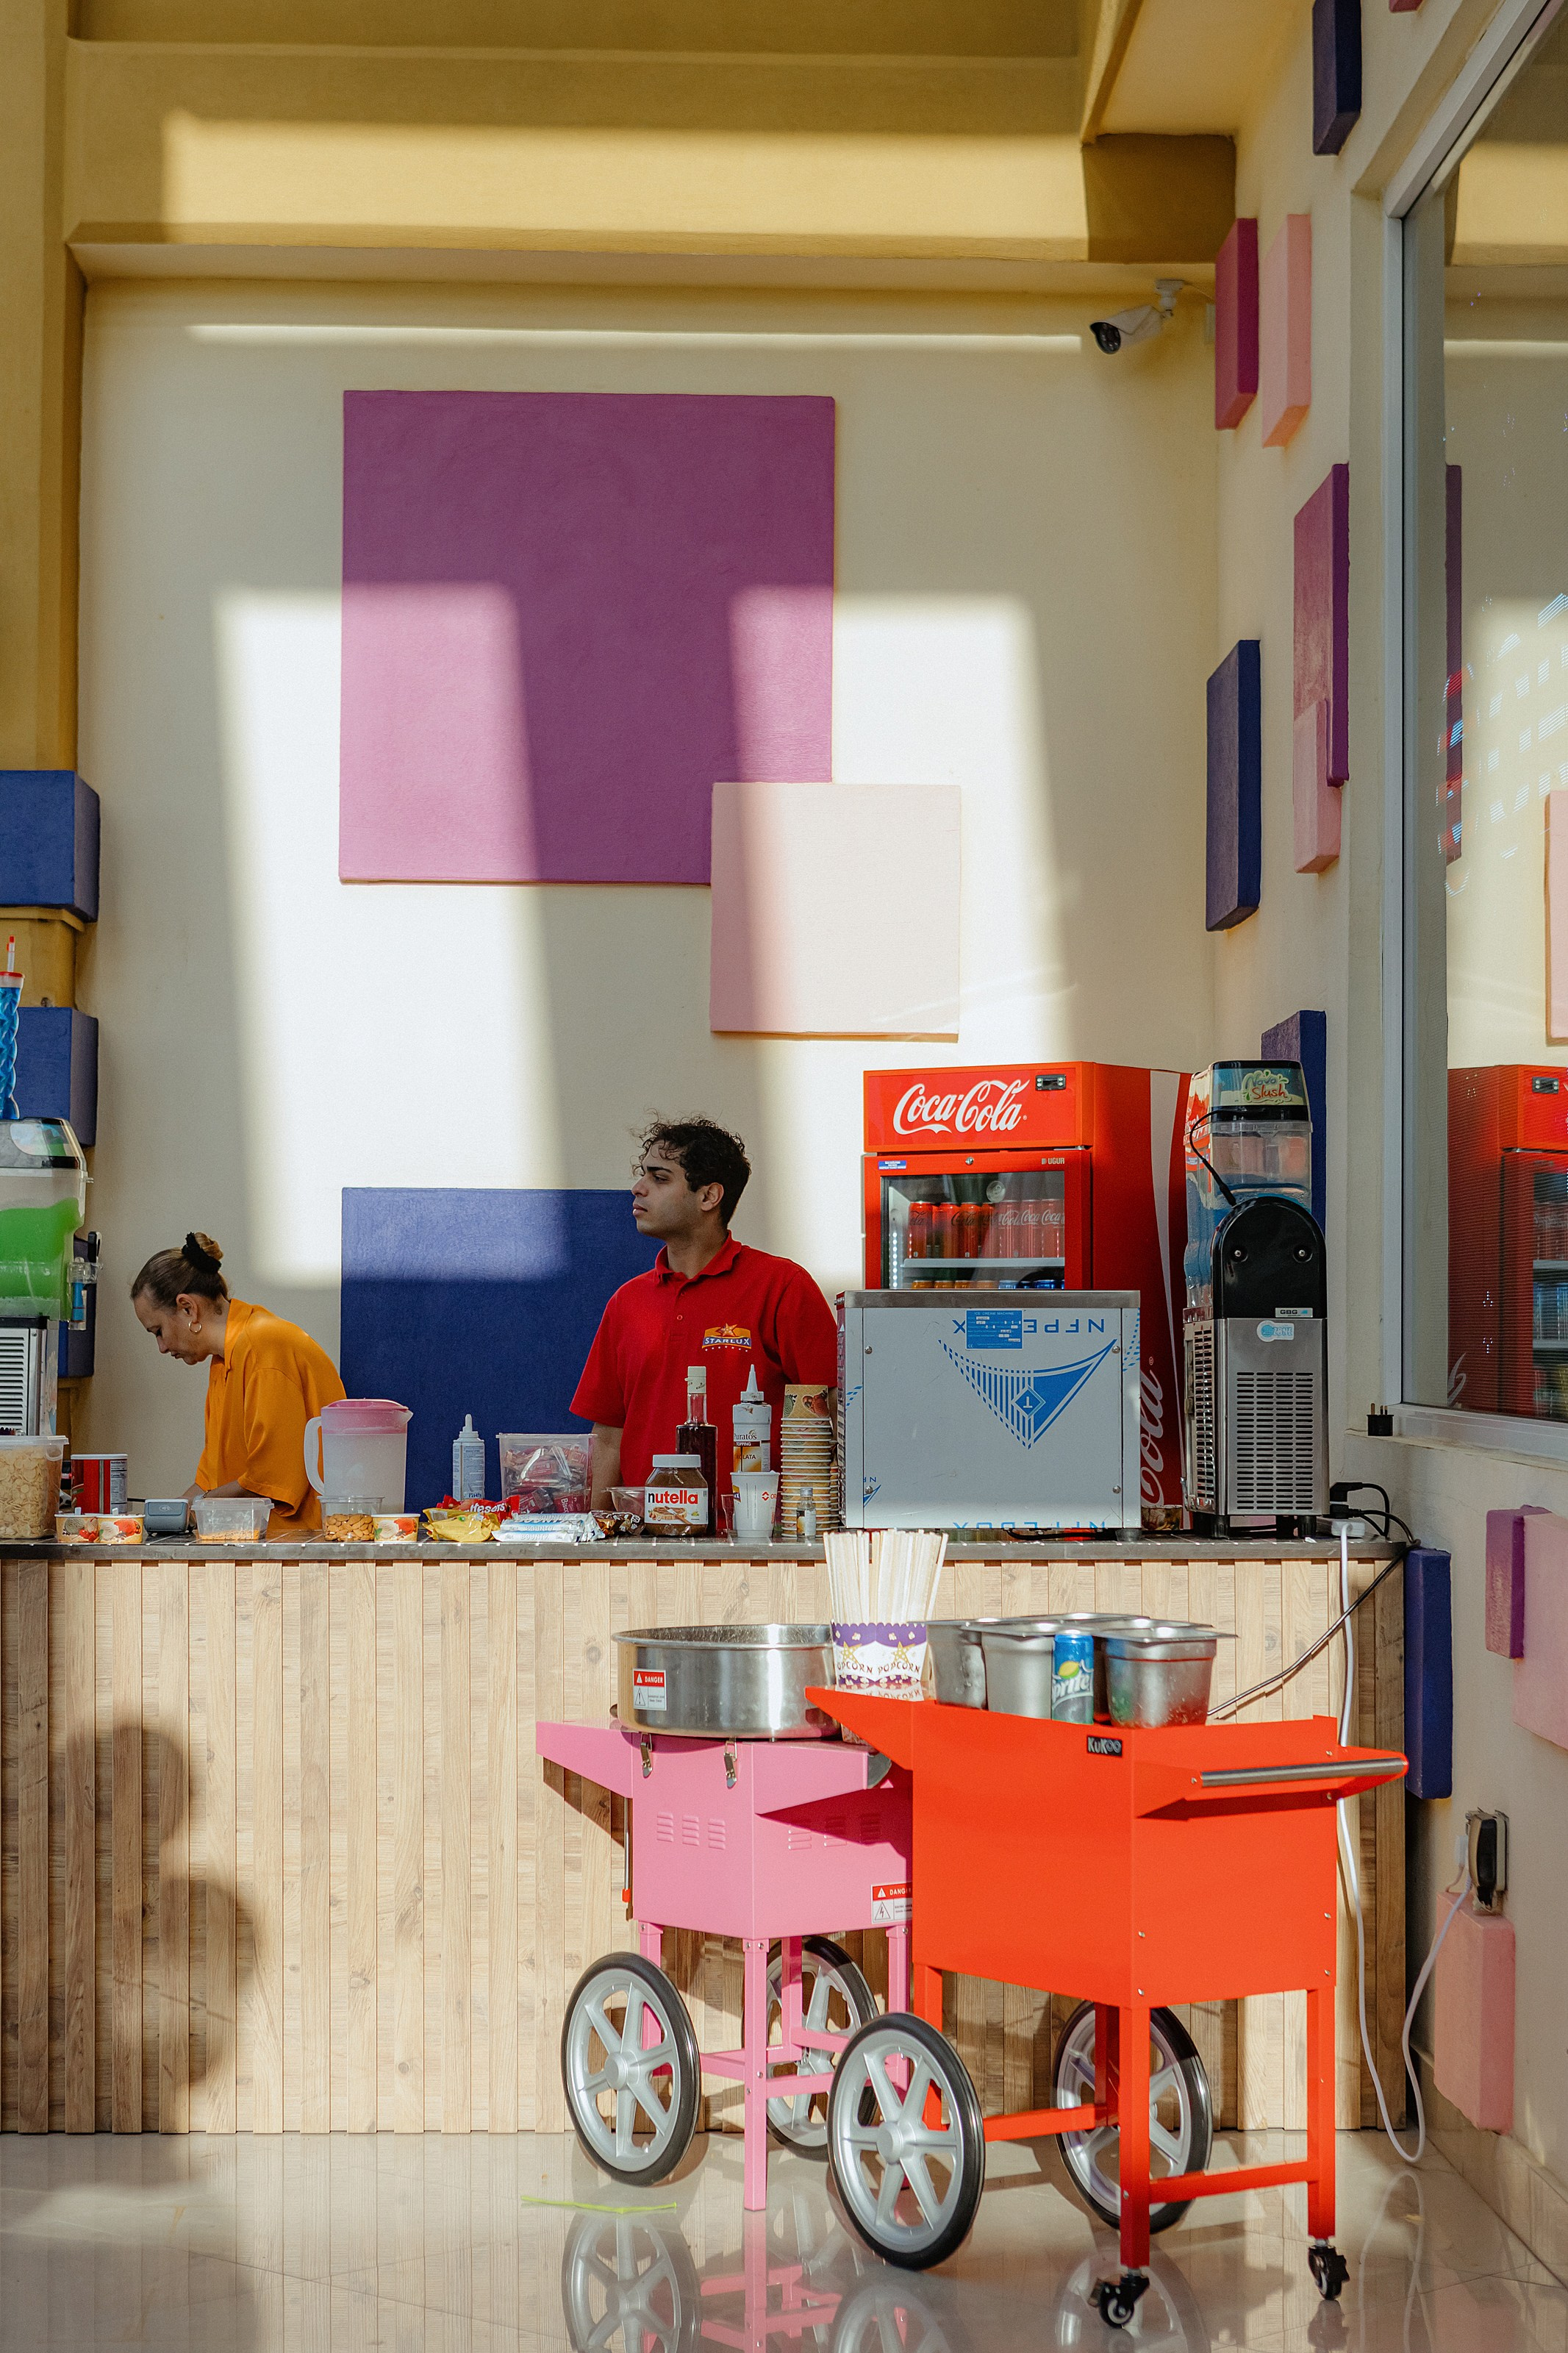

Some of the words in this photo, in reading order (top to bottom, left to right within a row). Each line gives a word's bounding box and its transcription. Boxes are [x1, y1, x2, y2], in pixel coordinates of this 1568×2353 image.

[1245, 1073, 1277, 1089] Novo
[1251, 1083, 1287, 1100] Slush
[892, 1079, 1030, 1135] Coca-Cola
[1041, 1209, 1061, 1226] Coca
[704, 1338, 750, 1346] STARLUX
[648, 1490, 698, 1504] nutella
[878, 1661, 920, 1675] POPCORN
[644, 1676, 664, 1684] DANGER
